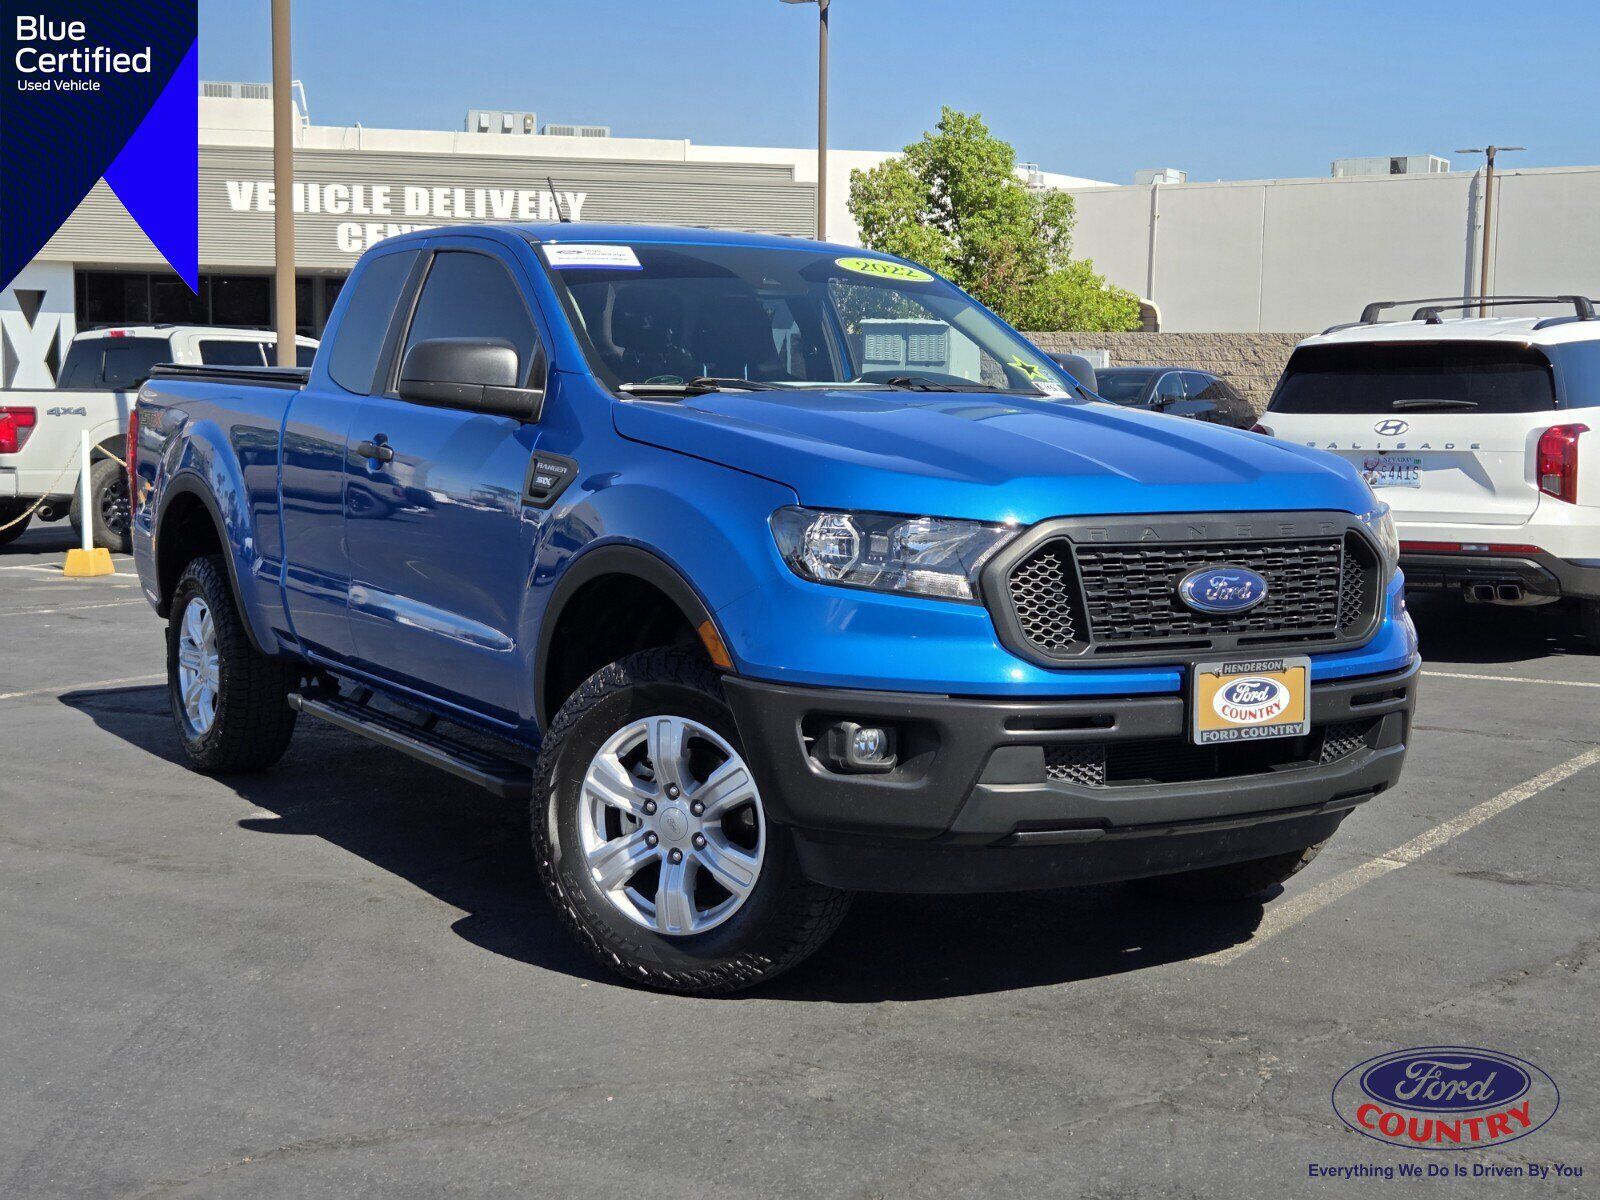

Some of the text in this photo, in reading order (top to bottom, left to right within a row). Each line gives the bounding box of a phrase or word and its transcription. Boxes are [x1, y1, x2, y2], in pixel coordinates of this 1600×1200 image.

[404, 187, 588, 221] DELIVERY
[856, 261, 918, 277] 2022
[537, 462, 567, 473] RANGER
[536, 476, 552, 485] STX
[1206, 574, 1252, 601] Ford
[1224, 661, 1283, 674] HENDERSON
[1232, 682, 1269, 702] Ford
[1221, 699, 1282, 721] COUNTRY
[1202, 723, 1303, 742] FORD COUNTRY
